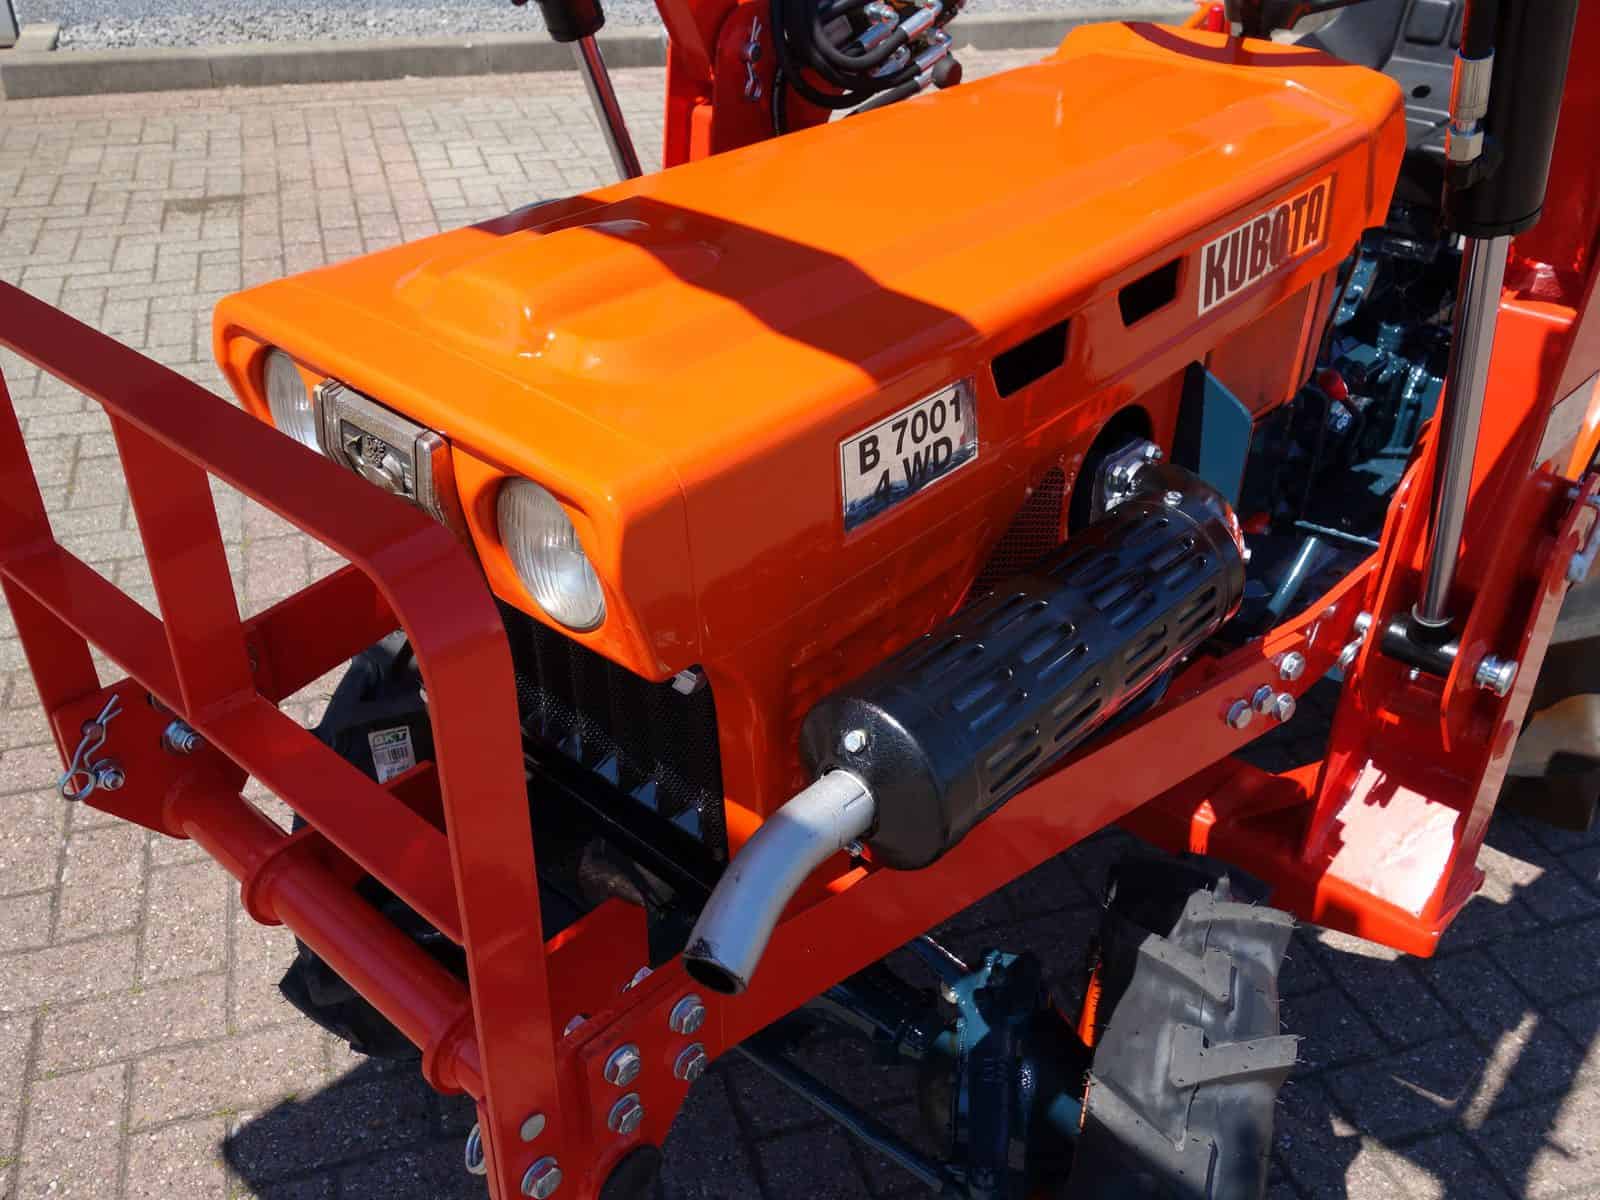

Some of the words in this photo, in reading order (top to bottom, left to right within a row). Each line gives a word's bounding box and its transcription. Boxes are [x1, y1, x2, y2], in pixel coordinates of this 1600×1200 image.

[1204, 184, 1326, 308] KUBOTA
[858, 434, 881, 475] B
[891, 389, 961, 455] 7001
[873, 467, 891, 504] 4
[902, 436, 953, 488] WD
